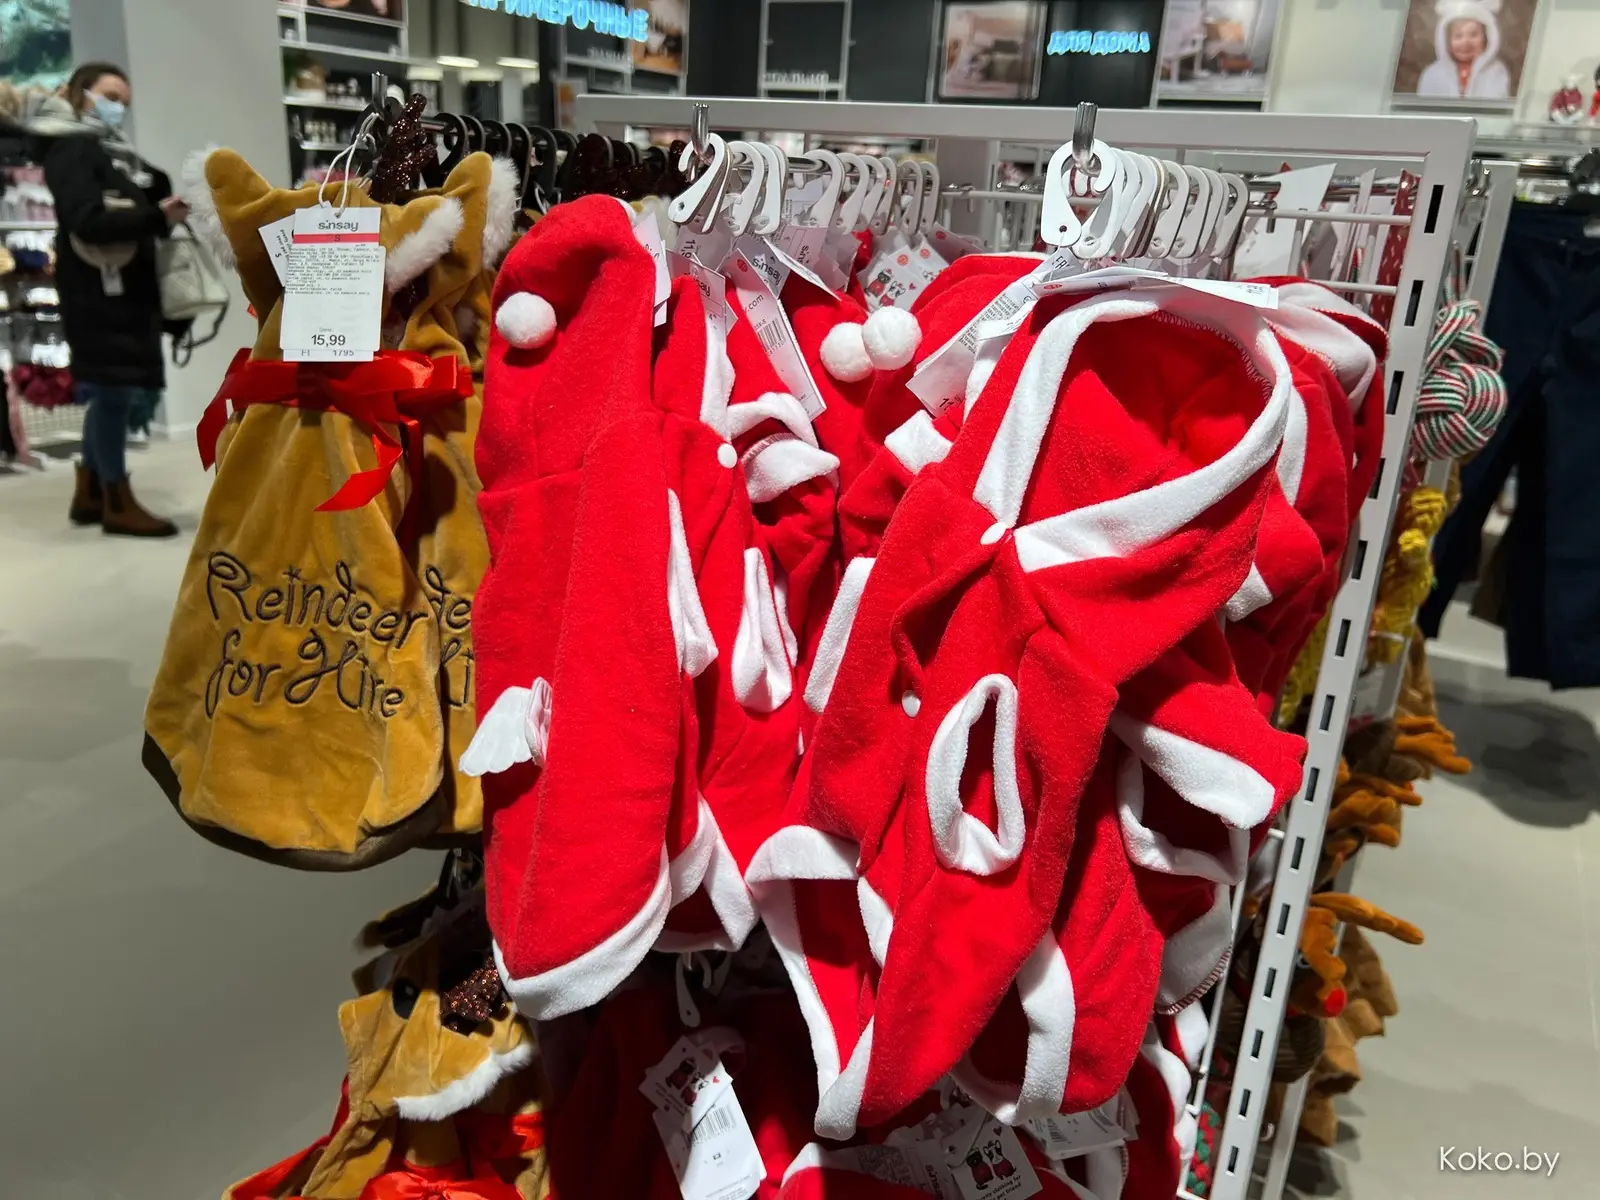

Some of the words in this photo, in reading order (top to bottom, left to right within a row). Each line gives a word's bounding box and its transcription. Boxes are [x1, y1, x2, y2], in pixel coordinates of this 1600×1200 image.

[465, 0, 650, 42] МЕРОЧНЫЕ
[318, 219, 359, 232] sinsay
[752, 257, 783, 286] sinsay
[744, 293, 765, 312] .com
[311, 334, 346, 347] 15,99
[206, 551, 428, 649] Reindeer
[205, 627, 281, 719] for
[284, 628, 404, 718] Hire
